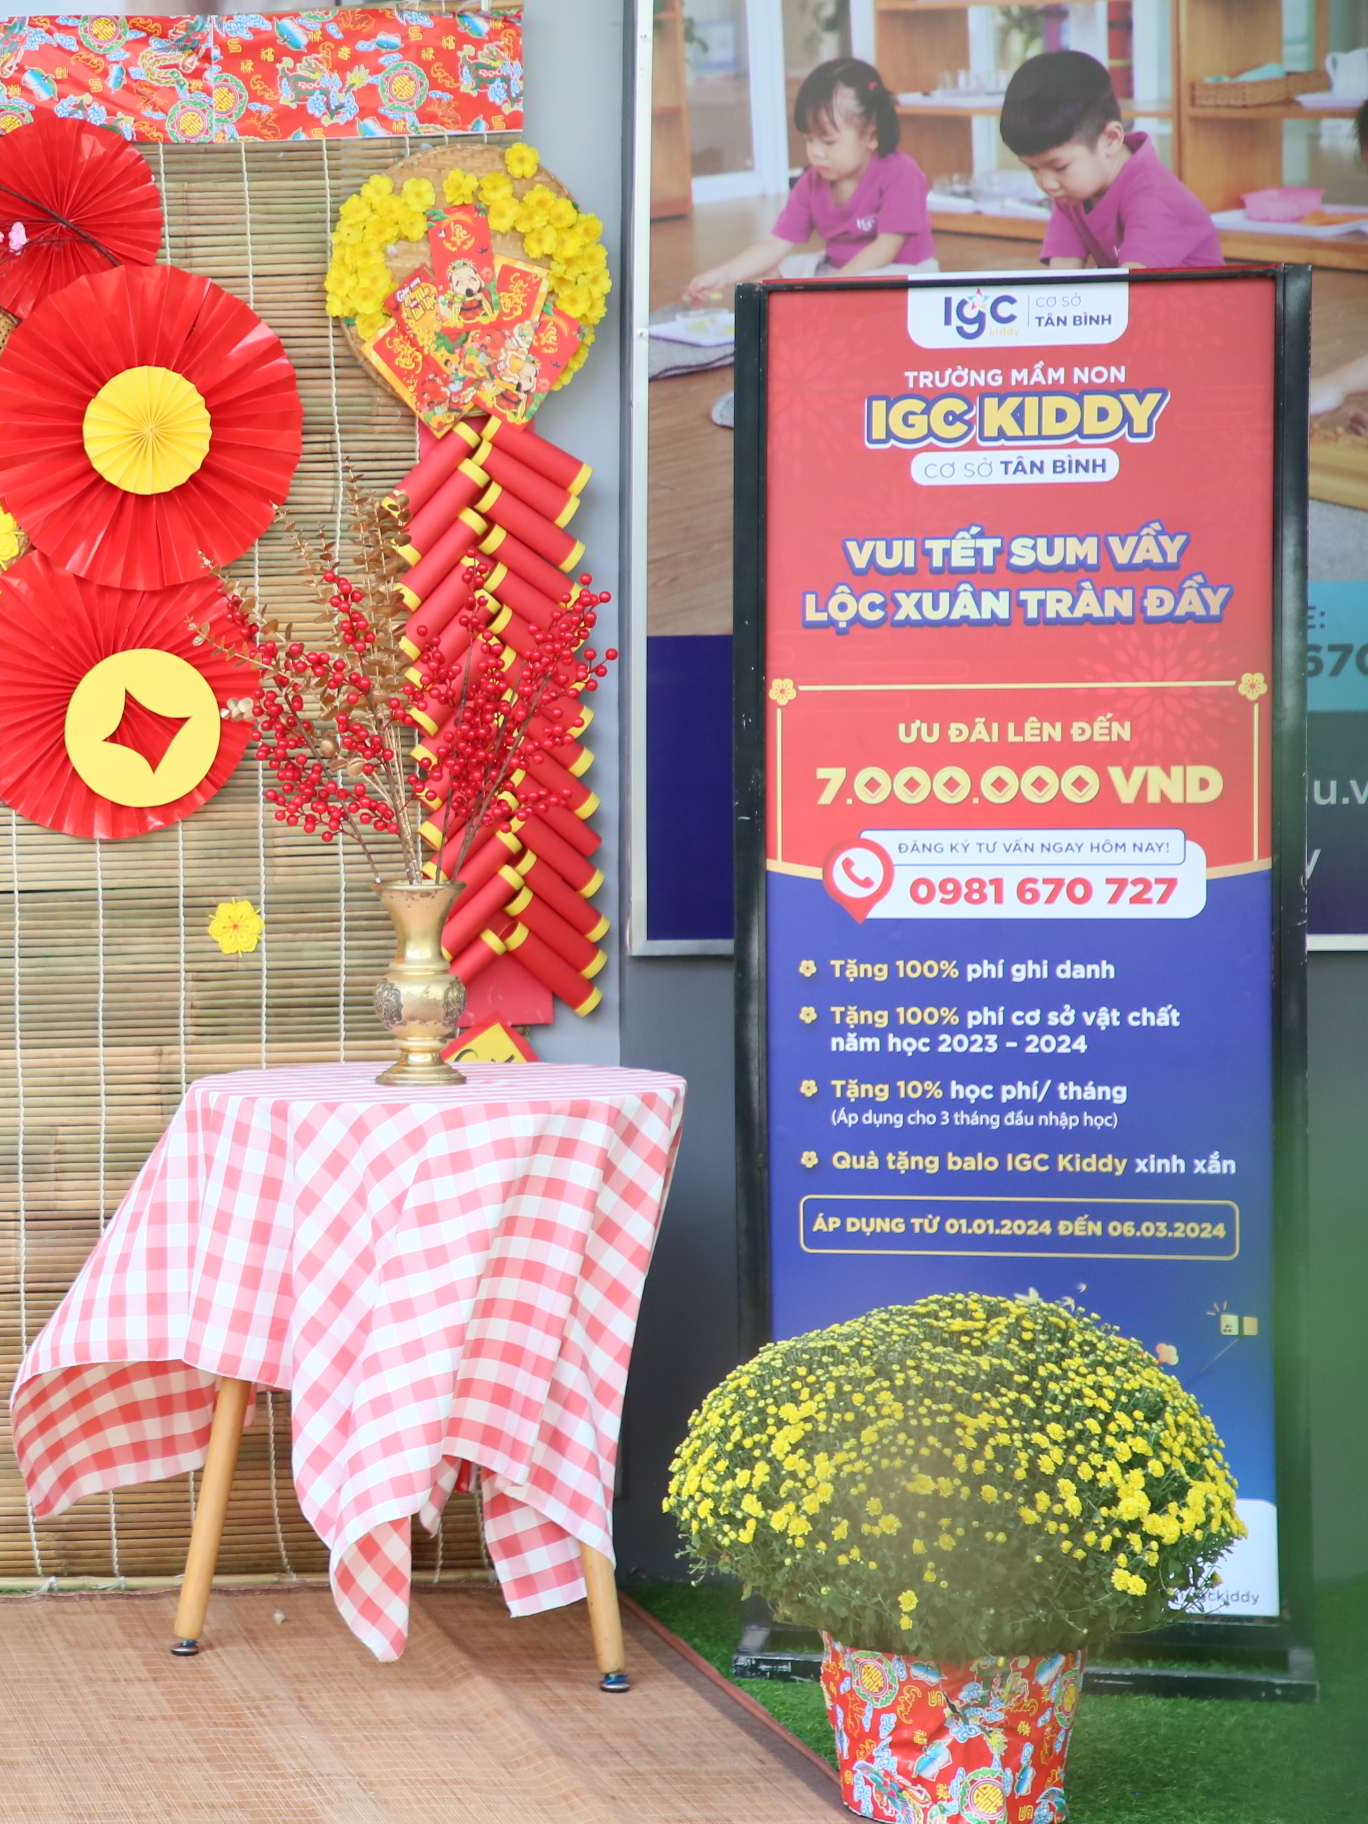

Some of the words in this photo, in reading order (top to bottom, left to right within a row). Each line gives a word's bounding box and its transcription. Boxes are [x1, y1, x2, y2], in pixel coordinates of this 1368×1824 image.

[1036, 296, 1057, 308] CƠ
[1062, 292, 1082, 307] SỞ
[1035, 313, 1068, 327] TÂN
[1073, 310, 1112, 326] BÌNH
[904, 366, 1003, 388] TRƯỜNG
[1011, 361, 1065, 385] MẦM
[1073, 366, 1126, 384] NON
[866, 394, 975, 448] IGC
[978, 389, 1170, 443] KIDDY
[924, 461, 956, 479] CƠ
[963, 457, 993, 478] SỞ
[1000, 456, 1045, 475] TÂN
[1052, 454, 1107, 474] BÌNH
[845, 538, 916, 574] VUI
[925, 524, 1002, 570] TẾT
[1010, 534, 1100, 568] SUM
[1105, 520, 1190, 571] VẦY
[803, 585, 888, 634] LỘC
[894, 582, 1009, 626] XUÂN
[1020, 580, 1133, 625] TRÀN
[1141, 572, 1234, 624] ĐẦY
[898, 721, 940, 743] ƯU
[948, 718, 998, 743] ĐÃI
[1007, 716, 1062, 742] LÊN
[1071, 713, 1131, 742] ĐẾN
[816, 765, 1100, 805] 7.000.000
[1107, 764, 1224, 804] VND
[897, 840, 944, 854] ĐĂNG
[950, 839, 970, 853] KÝ
[976, 840, 1000, 853] TƯ
[1003, 839, 1035, 853] VẤN
[1040, 840, 1085, 853] NGAY
[1090, 839, 1127, 853] HÔM
[1132, 841, 1170, 853] NAY!
[909, 877, 1004, 905] 0981
[1016, 877, 1093, 905] 670
[1105, 877, 1179, 905] 727
[831, 960, 888, 982] Tặng
[896, 960, 959, 979] 100%
[966, 960, 1003, 984] phí
[1011, 960, 1048, 984] ghi
[1056, 960, 1115, 980] danh
[831, 1006, 888, 1029] Tặng
[896, 1007, 959, 1026] 100%
[966, 1006, 1004, 1031] phí
[1011, 1010, 1041, 1026] cơ
[1048, 1005, 1075, 1027] sở
[1083, 1007, 1121, 1030] vật
[1128, 1004, 1180, 1027] chất
[831, 1034, 880, 1053] năm
[888, 1034, 930, 1056] học
[938, 1035, 998, 1054] 2023
[1025, 1036, 1087, 1054] 2024
[831, 1080, 889, 1101] Tặng
[896, 1080, 943, 1099] 10%
[950, 1080, 993, 1104] học
[1001, 1080, 1050, 1104] phí/
[1058, 1082, 1127, 1104] tháng
[831, 1108, 859, 1127] (Áp
[862, 1110, 903, 1128] dụng
[907, 1110, 936, 1125] cho
[940, 1111, 949, 1125] 3
[954, 1111, 1000, 1128] tháng
[1004, 1109, 1034, 1126] đầu
[1038, 1112, 1079, 1130] nhập
[1083, 1112, 1118, 1129] học)
[832, 1151, 879, 1170] Quà
[886, 1151, 939, 1174] tặng
[947, 1152, 999, 1171] balo
[1007, 1153, 1049, 1172] IGC
[1058, 1154, 1127, 1175] Kiddy
[1135, 1154, 1185, 1173] xinh
[1193, 1151, 1236, 1174] xắn
[812, 1213, 841, 1231] ÁP
[846, 1217, 905, 1236] DỤNG
[911, 1213, 940, 1233] TỪ
[945, 1218, 1052, 1235] 01.01.2024
[1057, 1214, 1102, 1236] ĐẾN
[1107, 1221, 1226, 1238] 06.03.2024
